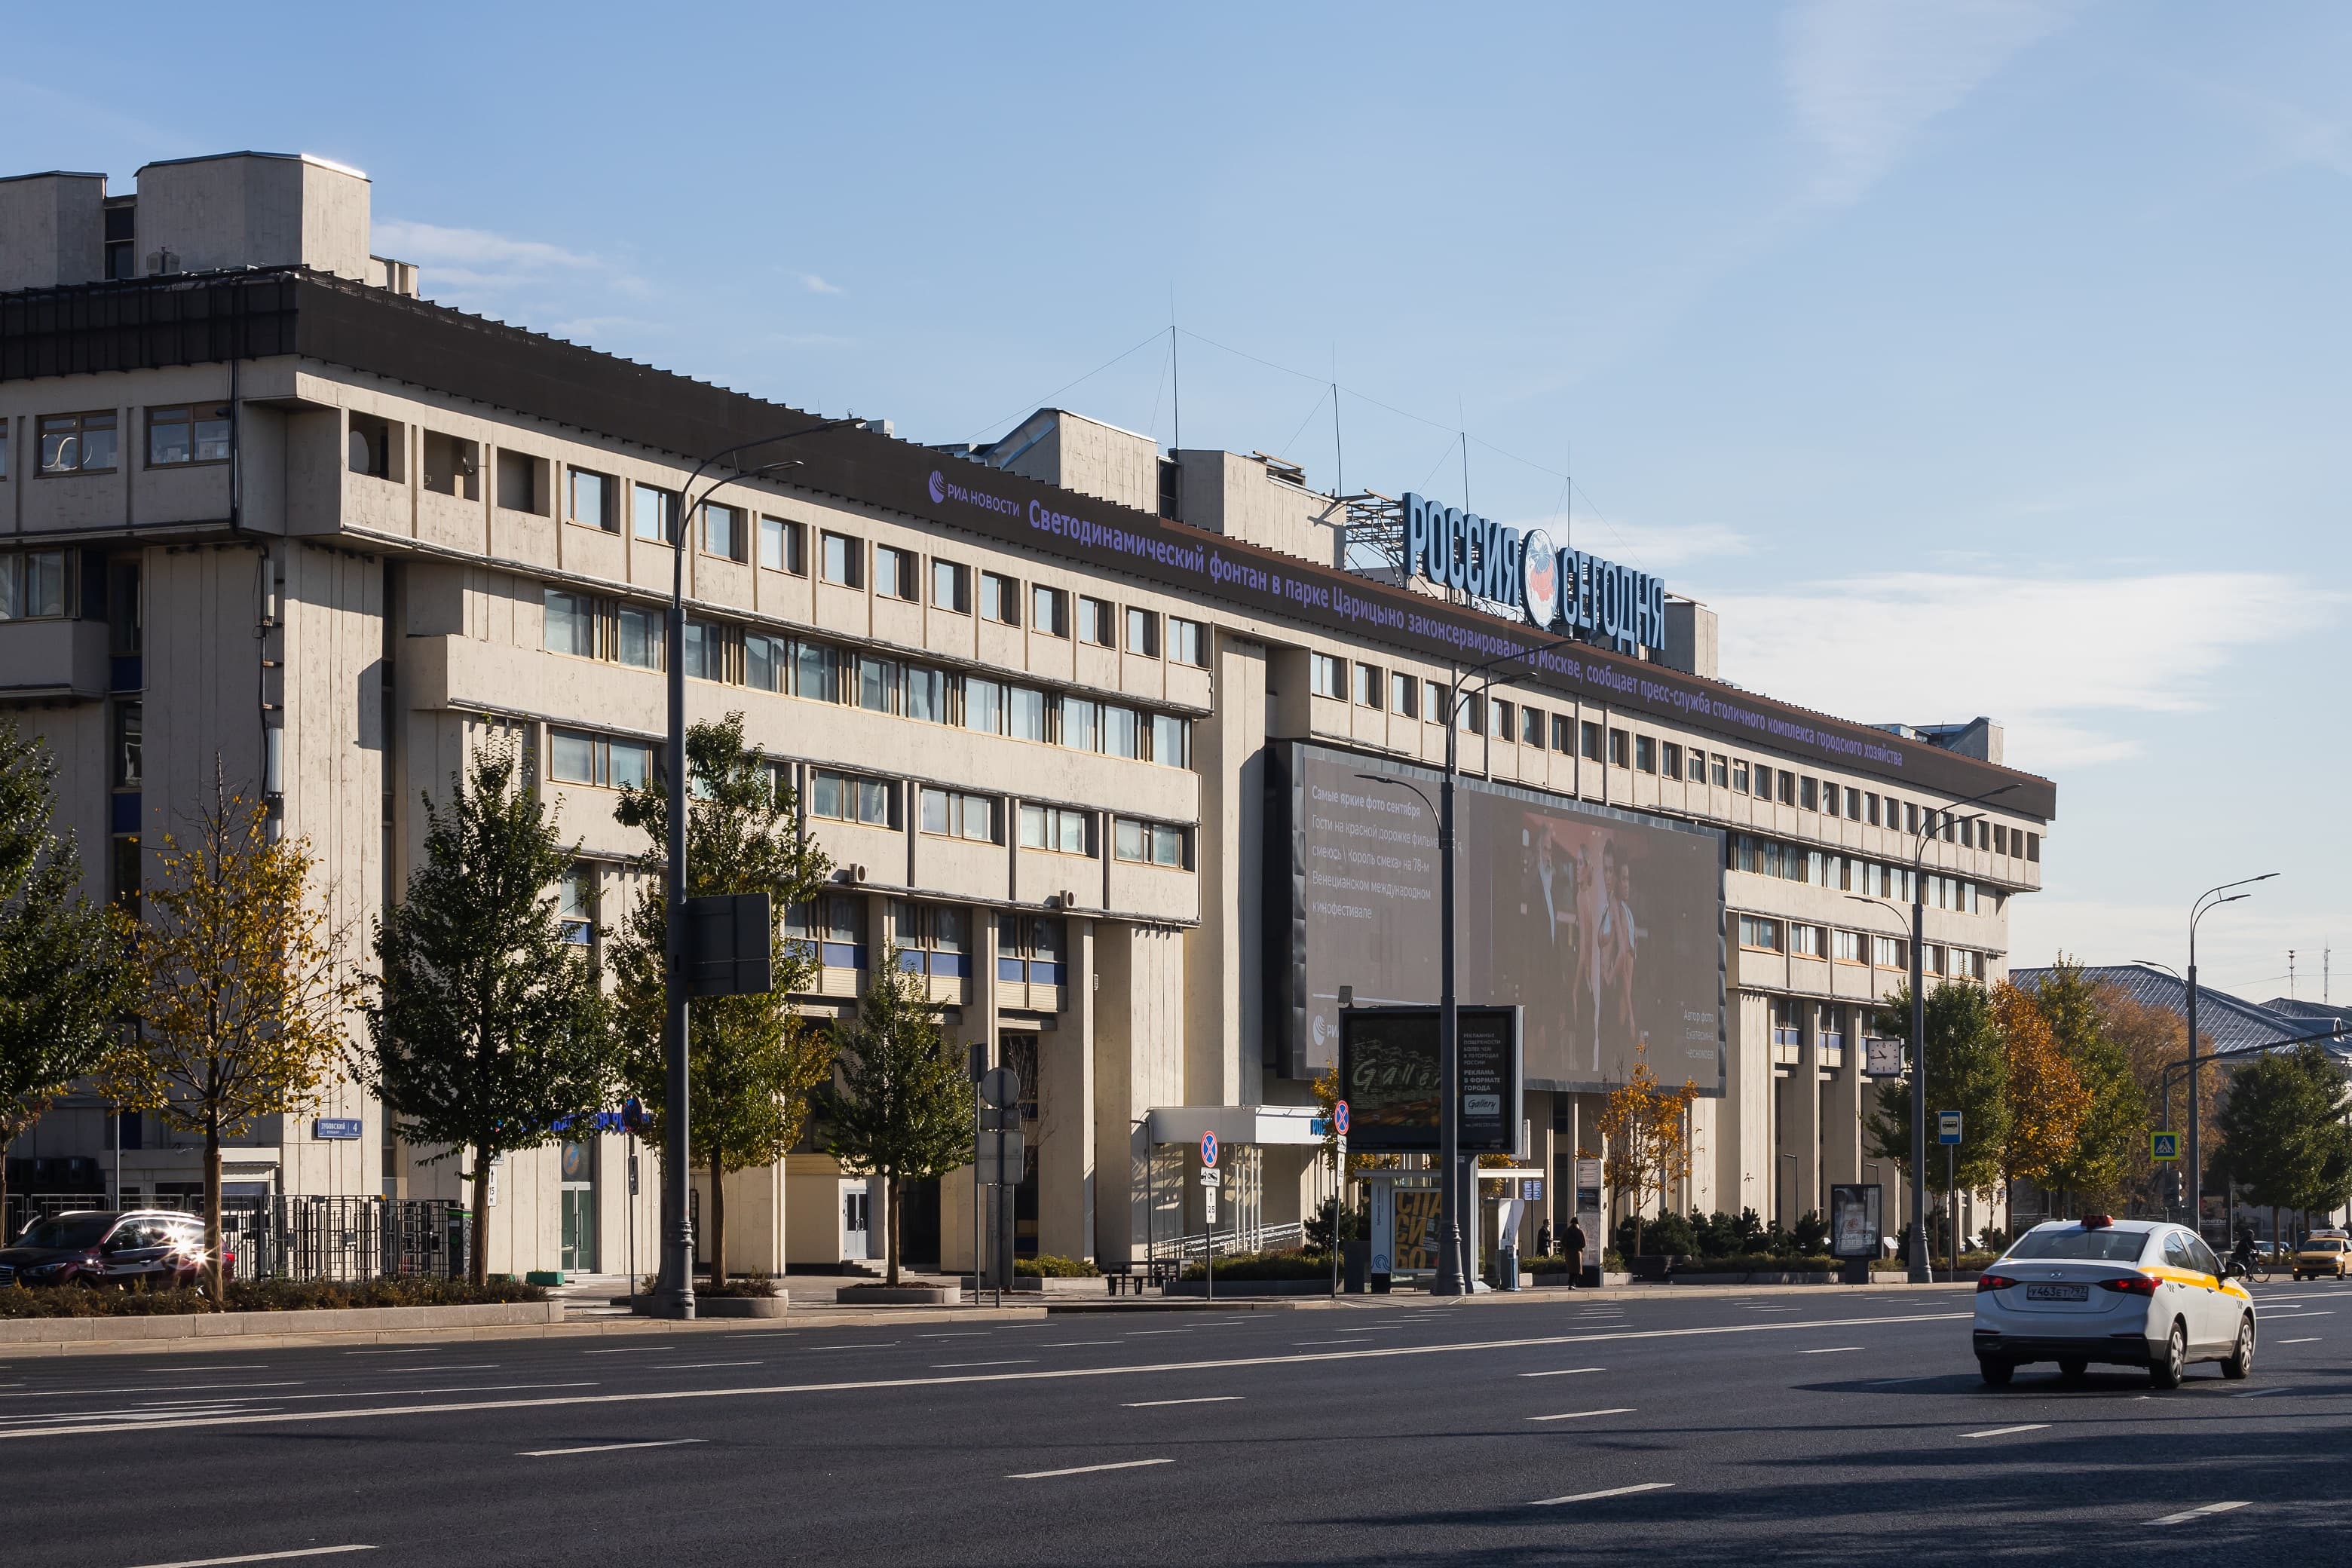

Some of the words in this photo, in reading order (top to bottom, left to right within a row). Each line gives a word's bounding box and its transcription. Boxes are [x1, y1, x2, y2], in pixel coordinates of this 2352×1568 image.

[948, 483, 969, 502] РИА
[970, 492, 1020, 518] НОВОСТИ
[1402, 492, 1520, 608] РОССИЯ
[1558, 547, 1664, 655] СЕГОДНЯ
[1028, 499, 1205, 574] Светодинамический
[1209, 550, 1266, 592] фонтан
[1272, 578, 1281, 595] в
[1285, 583, 1328, 609] парке
[1333, 586, 1404, 629] Царицыно
[1408, 612, 1524, 663] законсервировали
[1528, 648, 1536, 666] в
[1539, 649, 1584, 683] Москве,
[1586, 666, 1638, 697] сообщает
[1640, 681, 1710, 715] пресс-служба
[1712, 700, 1766, 730] столичного
[1768, 718, 1815, 743] комплекса
[1817, 731, 1863, 757] городского
[1864, 743, 1903, 767] хозяйства
[1312, 785, 1338, 803] Самые
[1340, 793, 1364, 808] яркие
[1366, 795, 1385, 812] фото
[1386, 801, 1421, 820] сентября
[1312, 814, 1333, 830] Гости
[1334, 822, 1344, 833] на
[1346, 823, 1377, 838] красной
[1379, 828, 1410, 844] дорожке
[1412, 831, 1439, 849] фильма
[1312, 845, 1342, 860] смеюсь
[1348, 848, 1376, 865] Король
[1403, 859, 1412, 871] на
[1413, 858, 1429, 874] 78-м
[1312, 871, 1370, 892] Венецианском
[1370, 881, 1432, 900] международном
[1312, 899, 1372, 919] кинофестивале
[1327, 1024, 1339, 1037] РИ
[1352, 1058, 1442, 1092] Galler
[1468, 1098, 1496, 1111] Gallery
[353, 1122, 358, 1132] 4
[1208, 1205, 1215, 1214] 25
[1396, 1214, 1428, 1248] СИ
[1395, 1244, 1427, 1269] БО
